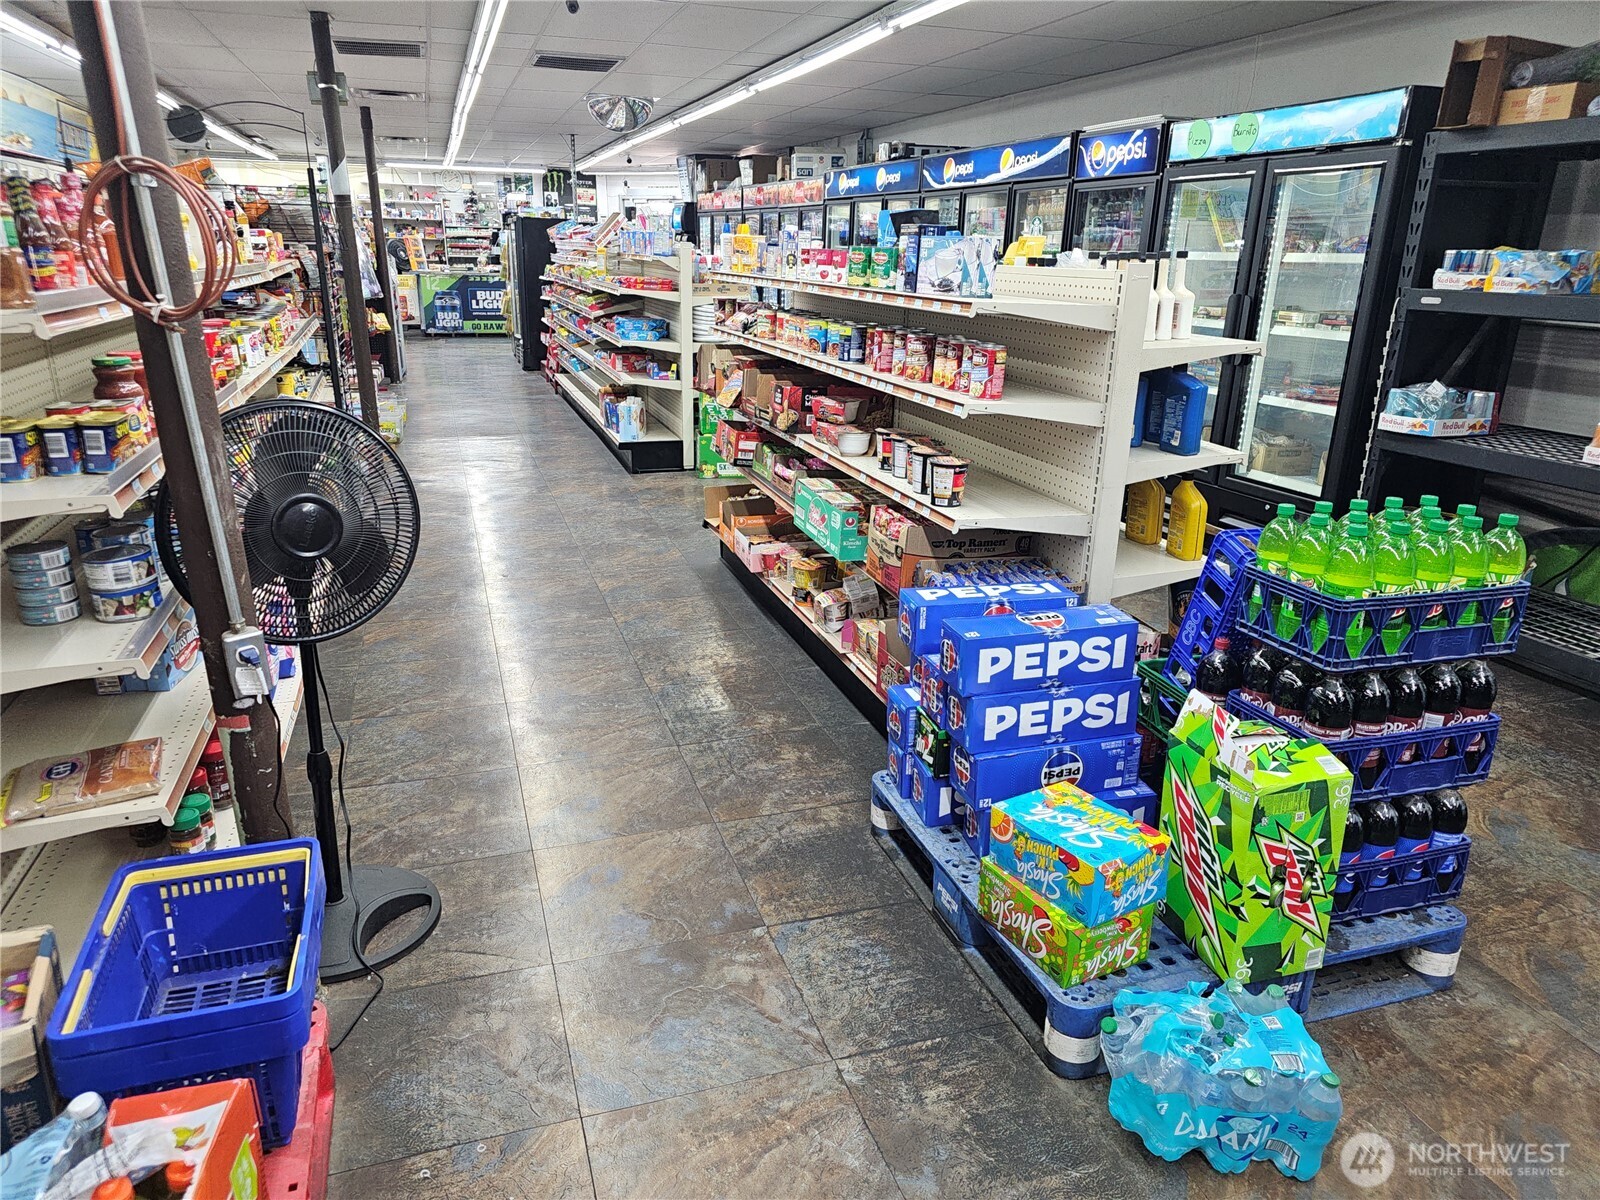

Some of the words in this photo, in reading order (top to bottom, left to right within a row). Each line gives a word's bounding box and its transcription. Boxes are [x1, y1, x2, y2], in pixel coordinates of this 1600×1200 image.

[1188, 131, 1206, 145] Pizza
[1013, 150, 1038, 168] pepsi
[1106, 136, 1147, 168] pepsi
[955, 160, 974, 175] pepsi
[844, 176, 860, 189] pepsi
[885, 171, 901, 185] pepsi
[471, 300, 502, 309] LIGH
[437, 312, 460, 320] BUD
[471, 323, 481, 331] GO
[1441, 421, 1453, 430] Red
[1453, 421, 1465, 430] Bull
[945, 539, 965, 549] Top
[968, 538, 1005, 547] Ramen
[916, 582, 1063, 601] PEPSI
[1021, 613, 1060, 621] PEPSI
[1181, 608, 1201, 646] CBC
[977, 633, 1128, 683] PEPSI
[983, 690, 1130, 741] PEPSI
[1043, 766, 1081, 780] PEPSI
[1216, 779, 1251, 804] RECYCLE
[1024, 801, 1129, 848] Shasta
[1027, 839, 1059, 858] PUNCH
[1035, 854, 1055, 872] TIKI
[1125, 852, 1157, 882] PUNCH
[981, 864, 1011, 897] Strawberry
[1013, 858, 1063, 899] Shasta
[1111, 868, 1163, 920] Shasta
[987, 893, 1052, 959] Shasta
[1091, 923, 1123, 937] Strawberry
[1084, 927, 1143, 979] Shasta
[1235, 956, 1253, 985] 36
[1286, 1123, 1308, 1141] 24
